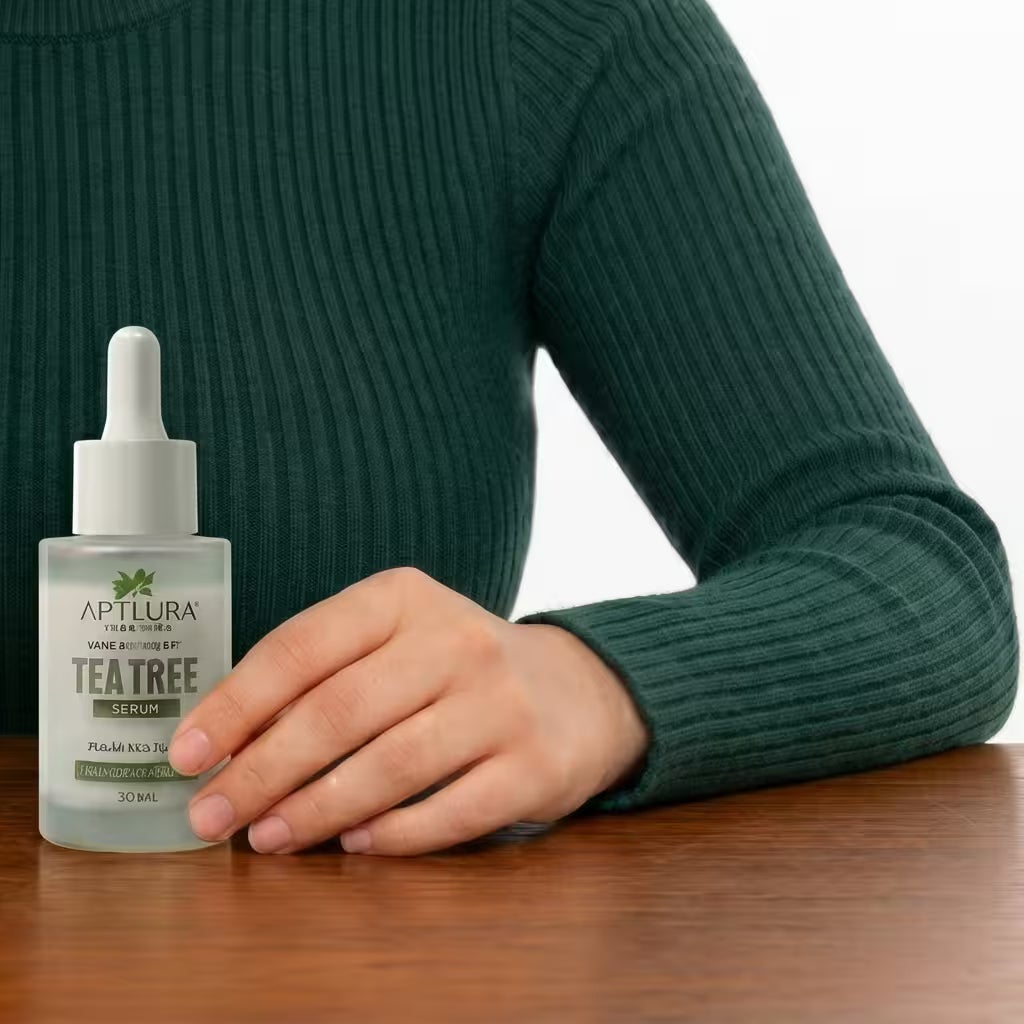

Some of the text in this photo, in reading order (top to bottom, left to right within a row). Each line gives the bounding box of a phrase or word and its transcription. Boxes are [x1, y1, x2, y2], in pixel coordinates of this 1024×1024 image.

[87, 641, 116, 650] VANE
[72, 657, 198, 694] TEA TREE
[112, 703, 159, 715] SERUM
[118, 792, 134, 803] 30
